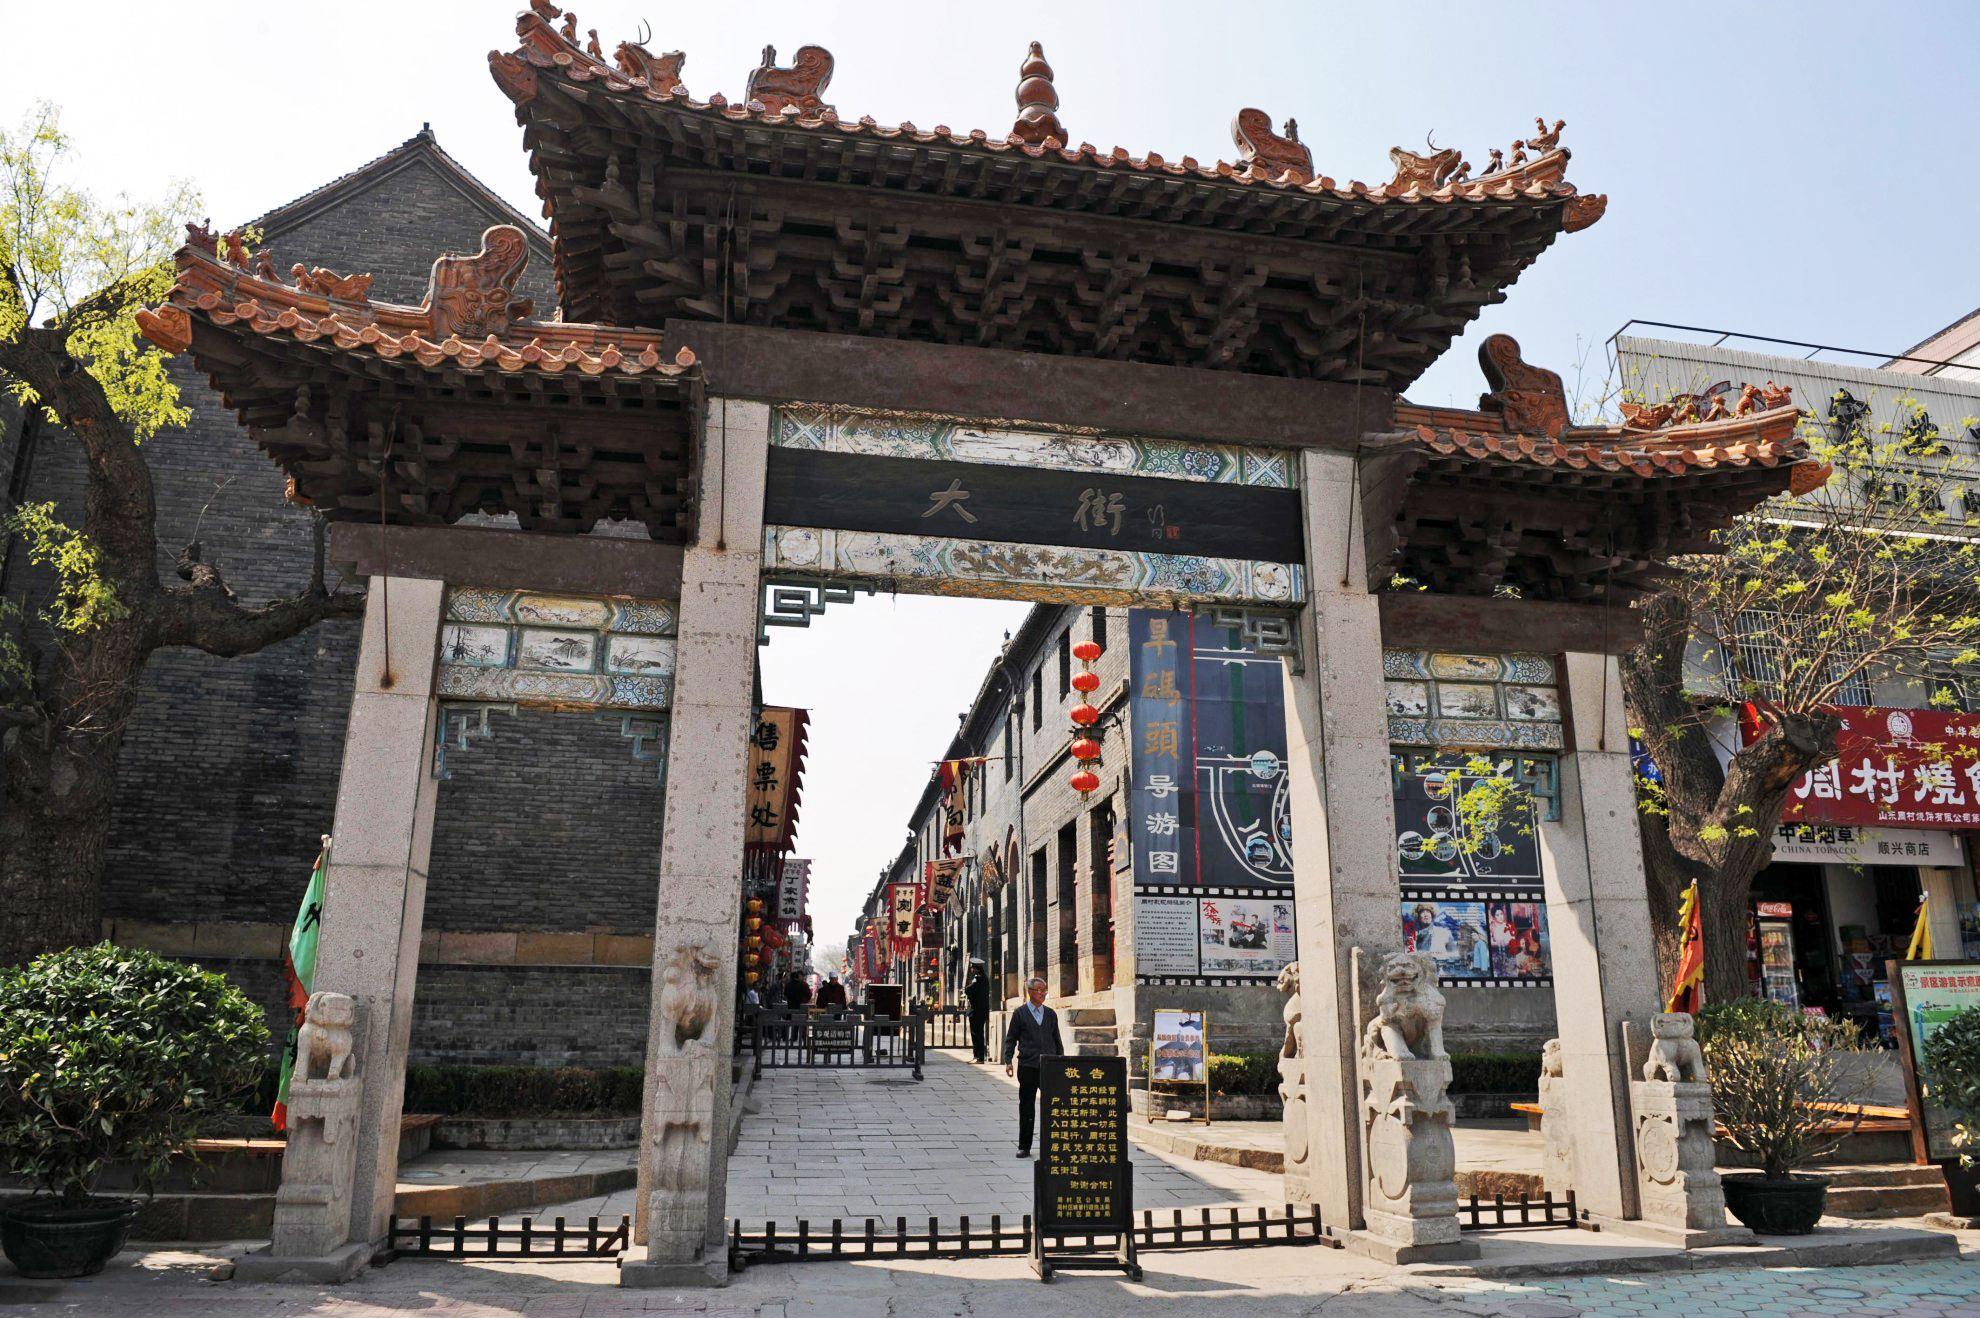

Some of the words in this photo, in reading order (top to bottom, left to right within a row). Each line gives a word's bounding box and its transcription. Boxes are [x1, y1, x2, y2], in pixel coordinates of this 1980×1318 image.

[921, 478, 1127, 536] 大街
[750, 722, 779, 829] 售票处
[1144, 774, 1179, 875] 导游图
[1779, 825, 1854, 845] 中国烟草
[1781, 845, 1811, 854] CHINA
[1814, 846, 1857, 855] TOBACCO
[1877, 842, 1930, 857] 顺兴商店
[896, 898, 912, 935] 刻章
[1065, 1067, 1105, 1080] 敬告
[1070, 1086, 1117, 1095] 景区内经营
[1051, 1119, 1117, 1129] 入口禁止一切车
